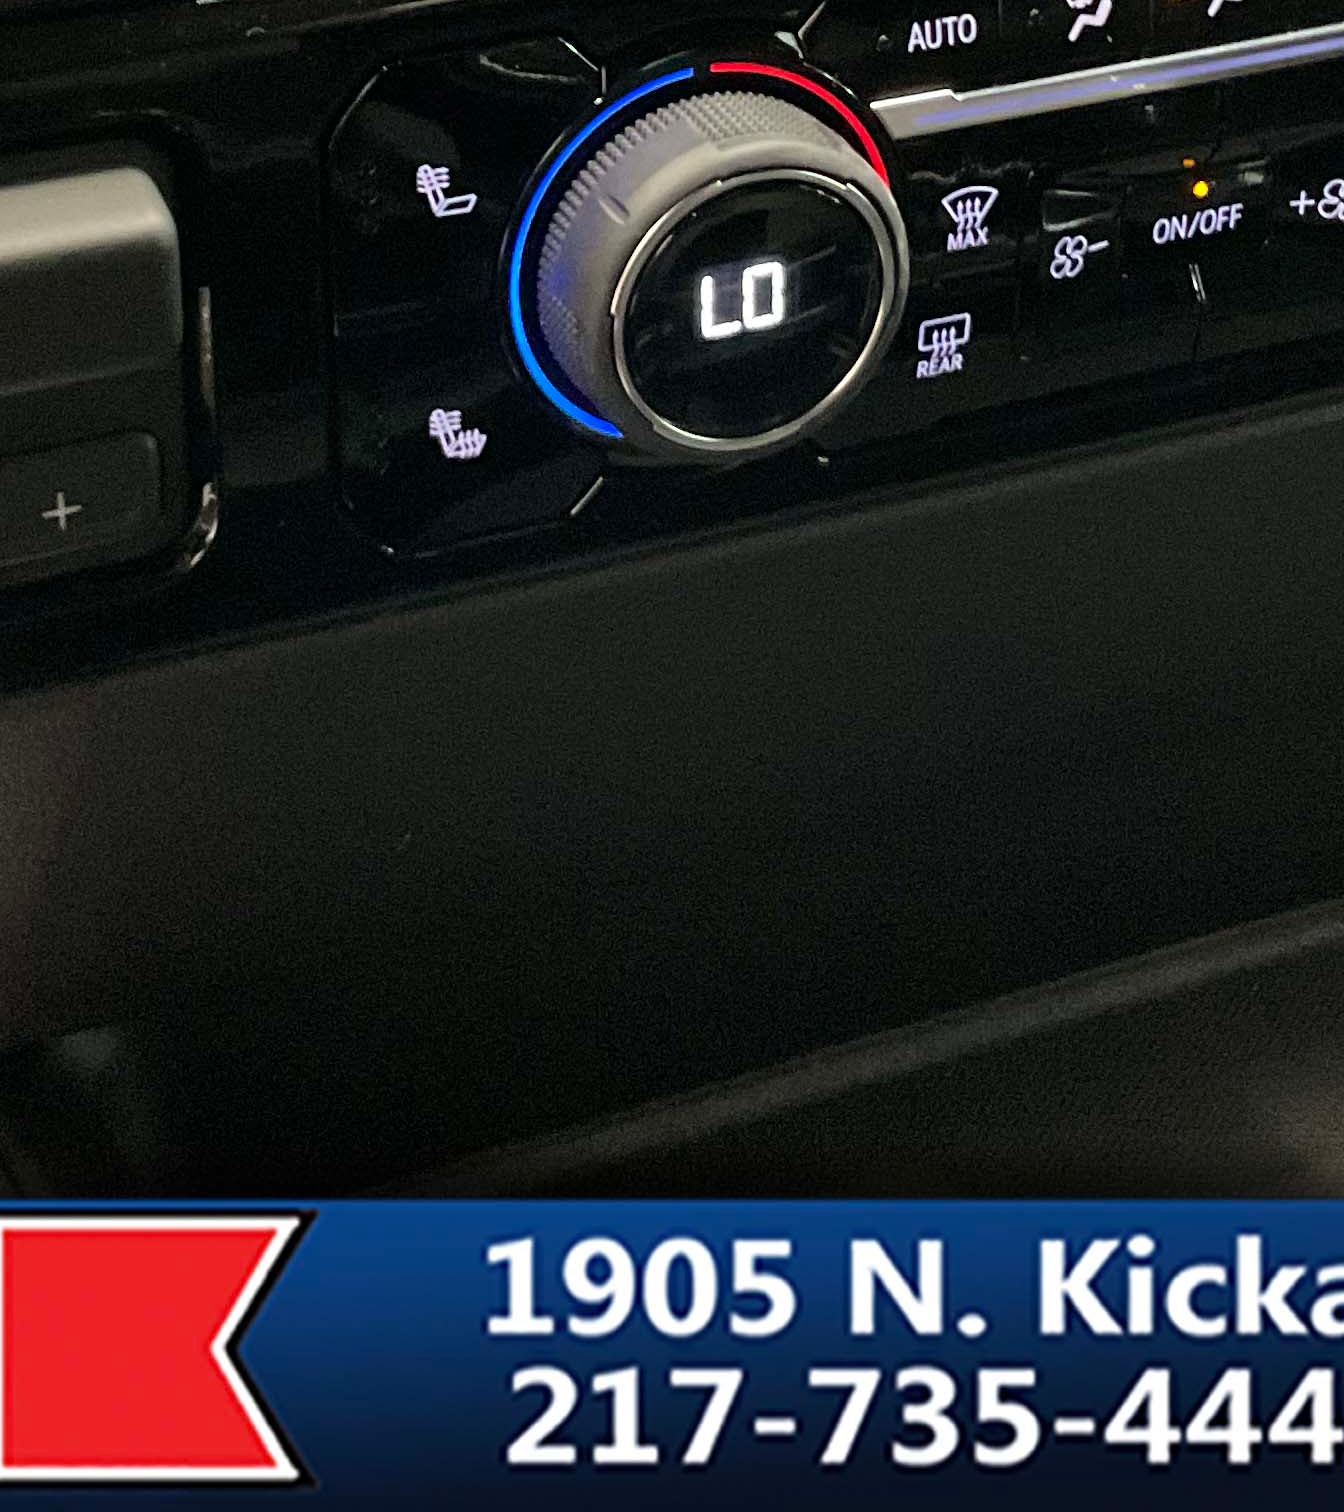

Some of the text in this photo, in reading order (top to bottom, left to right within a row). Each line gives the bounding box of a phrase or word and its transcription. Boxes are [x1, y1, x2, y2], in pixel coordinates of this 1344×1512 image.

[907, 13, 977, 52] AUTO
[947, 227, 988, 251] MAX
[1152, 202, 1244, 244] ON/OFF
[700, 261, 785, 339] LO
[916, 353, 963, 378] REAR
